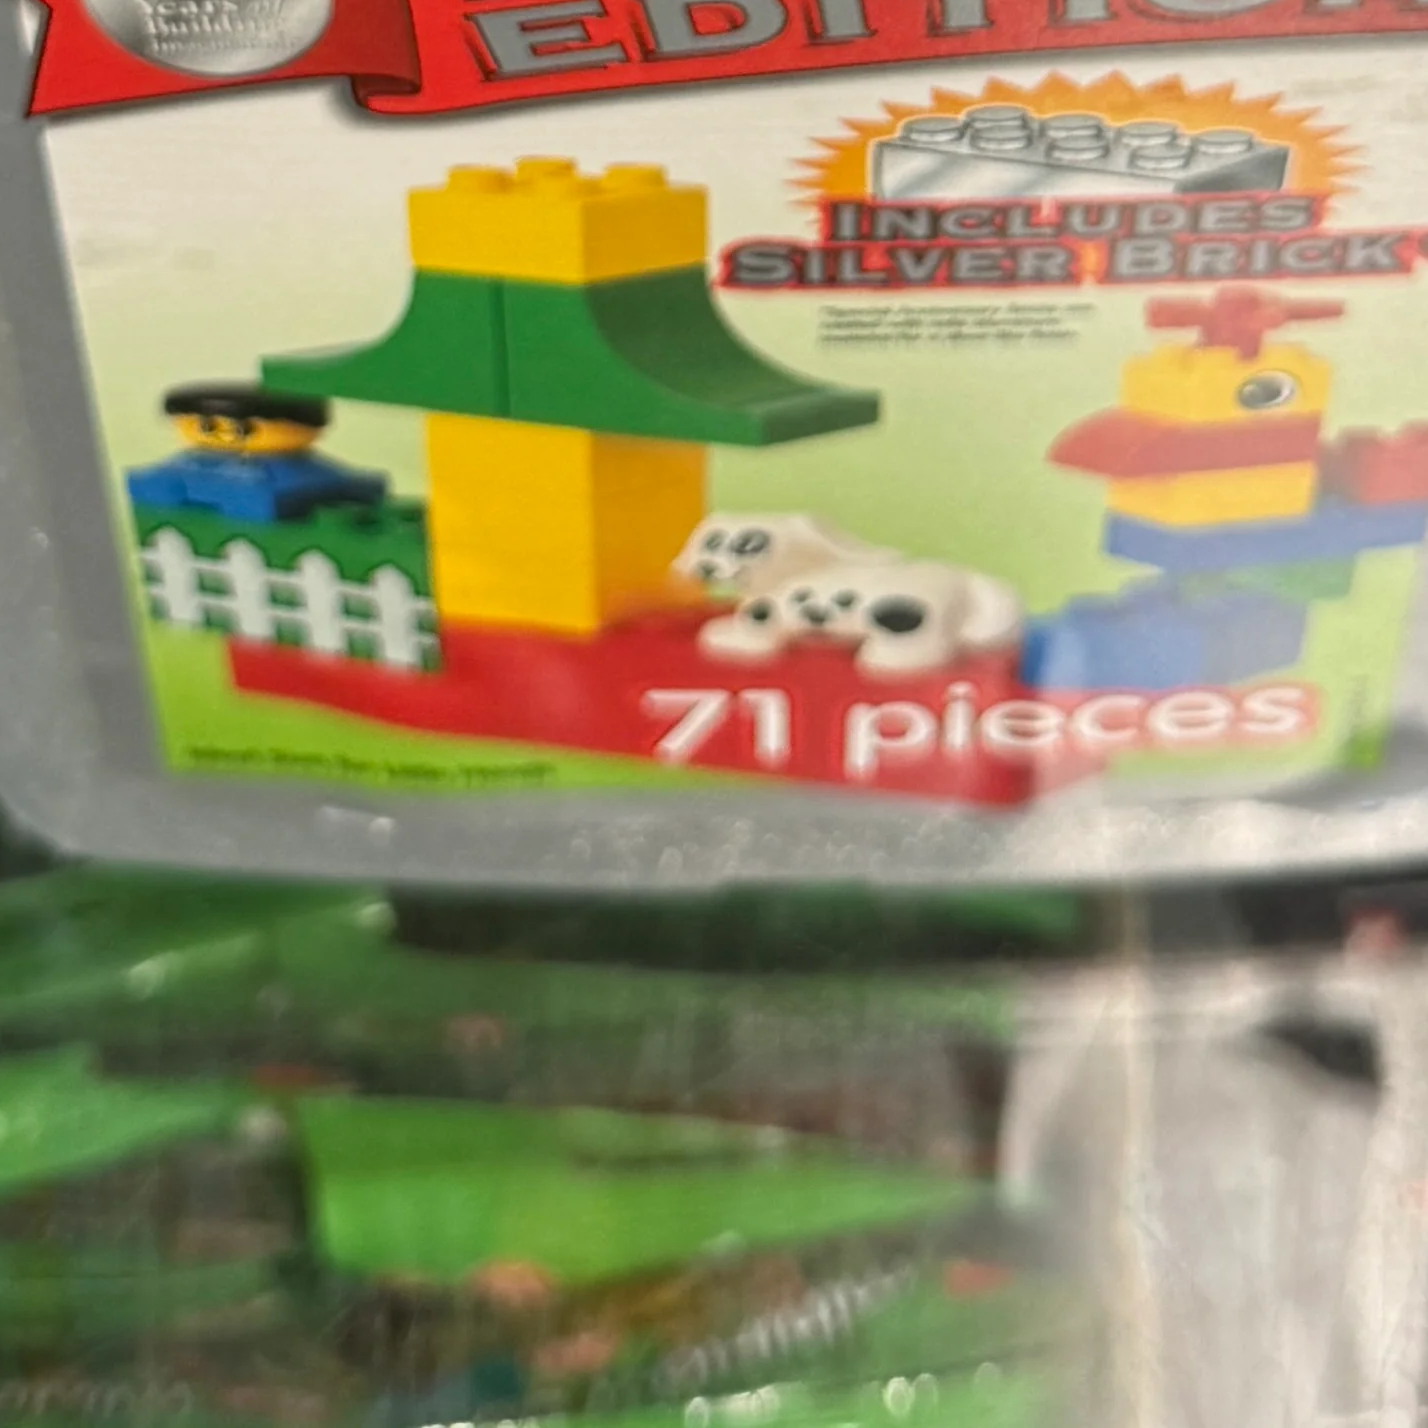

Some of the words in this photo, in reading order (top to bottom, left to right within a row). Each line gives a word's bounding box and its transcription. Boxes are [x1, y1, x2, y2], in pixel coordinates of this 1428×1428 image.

[825, 196, 1318, 244] INCLUDES
[727, 242, 1075, 287] SILVER
[641, 686, 792, 767] 71
[842, 680, 1308, 782] pieces
